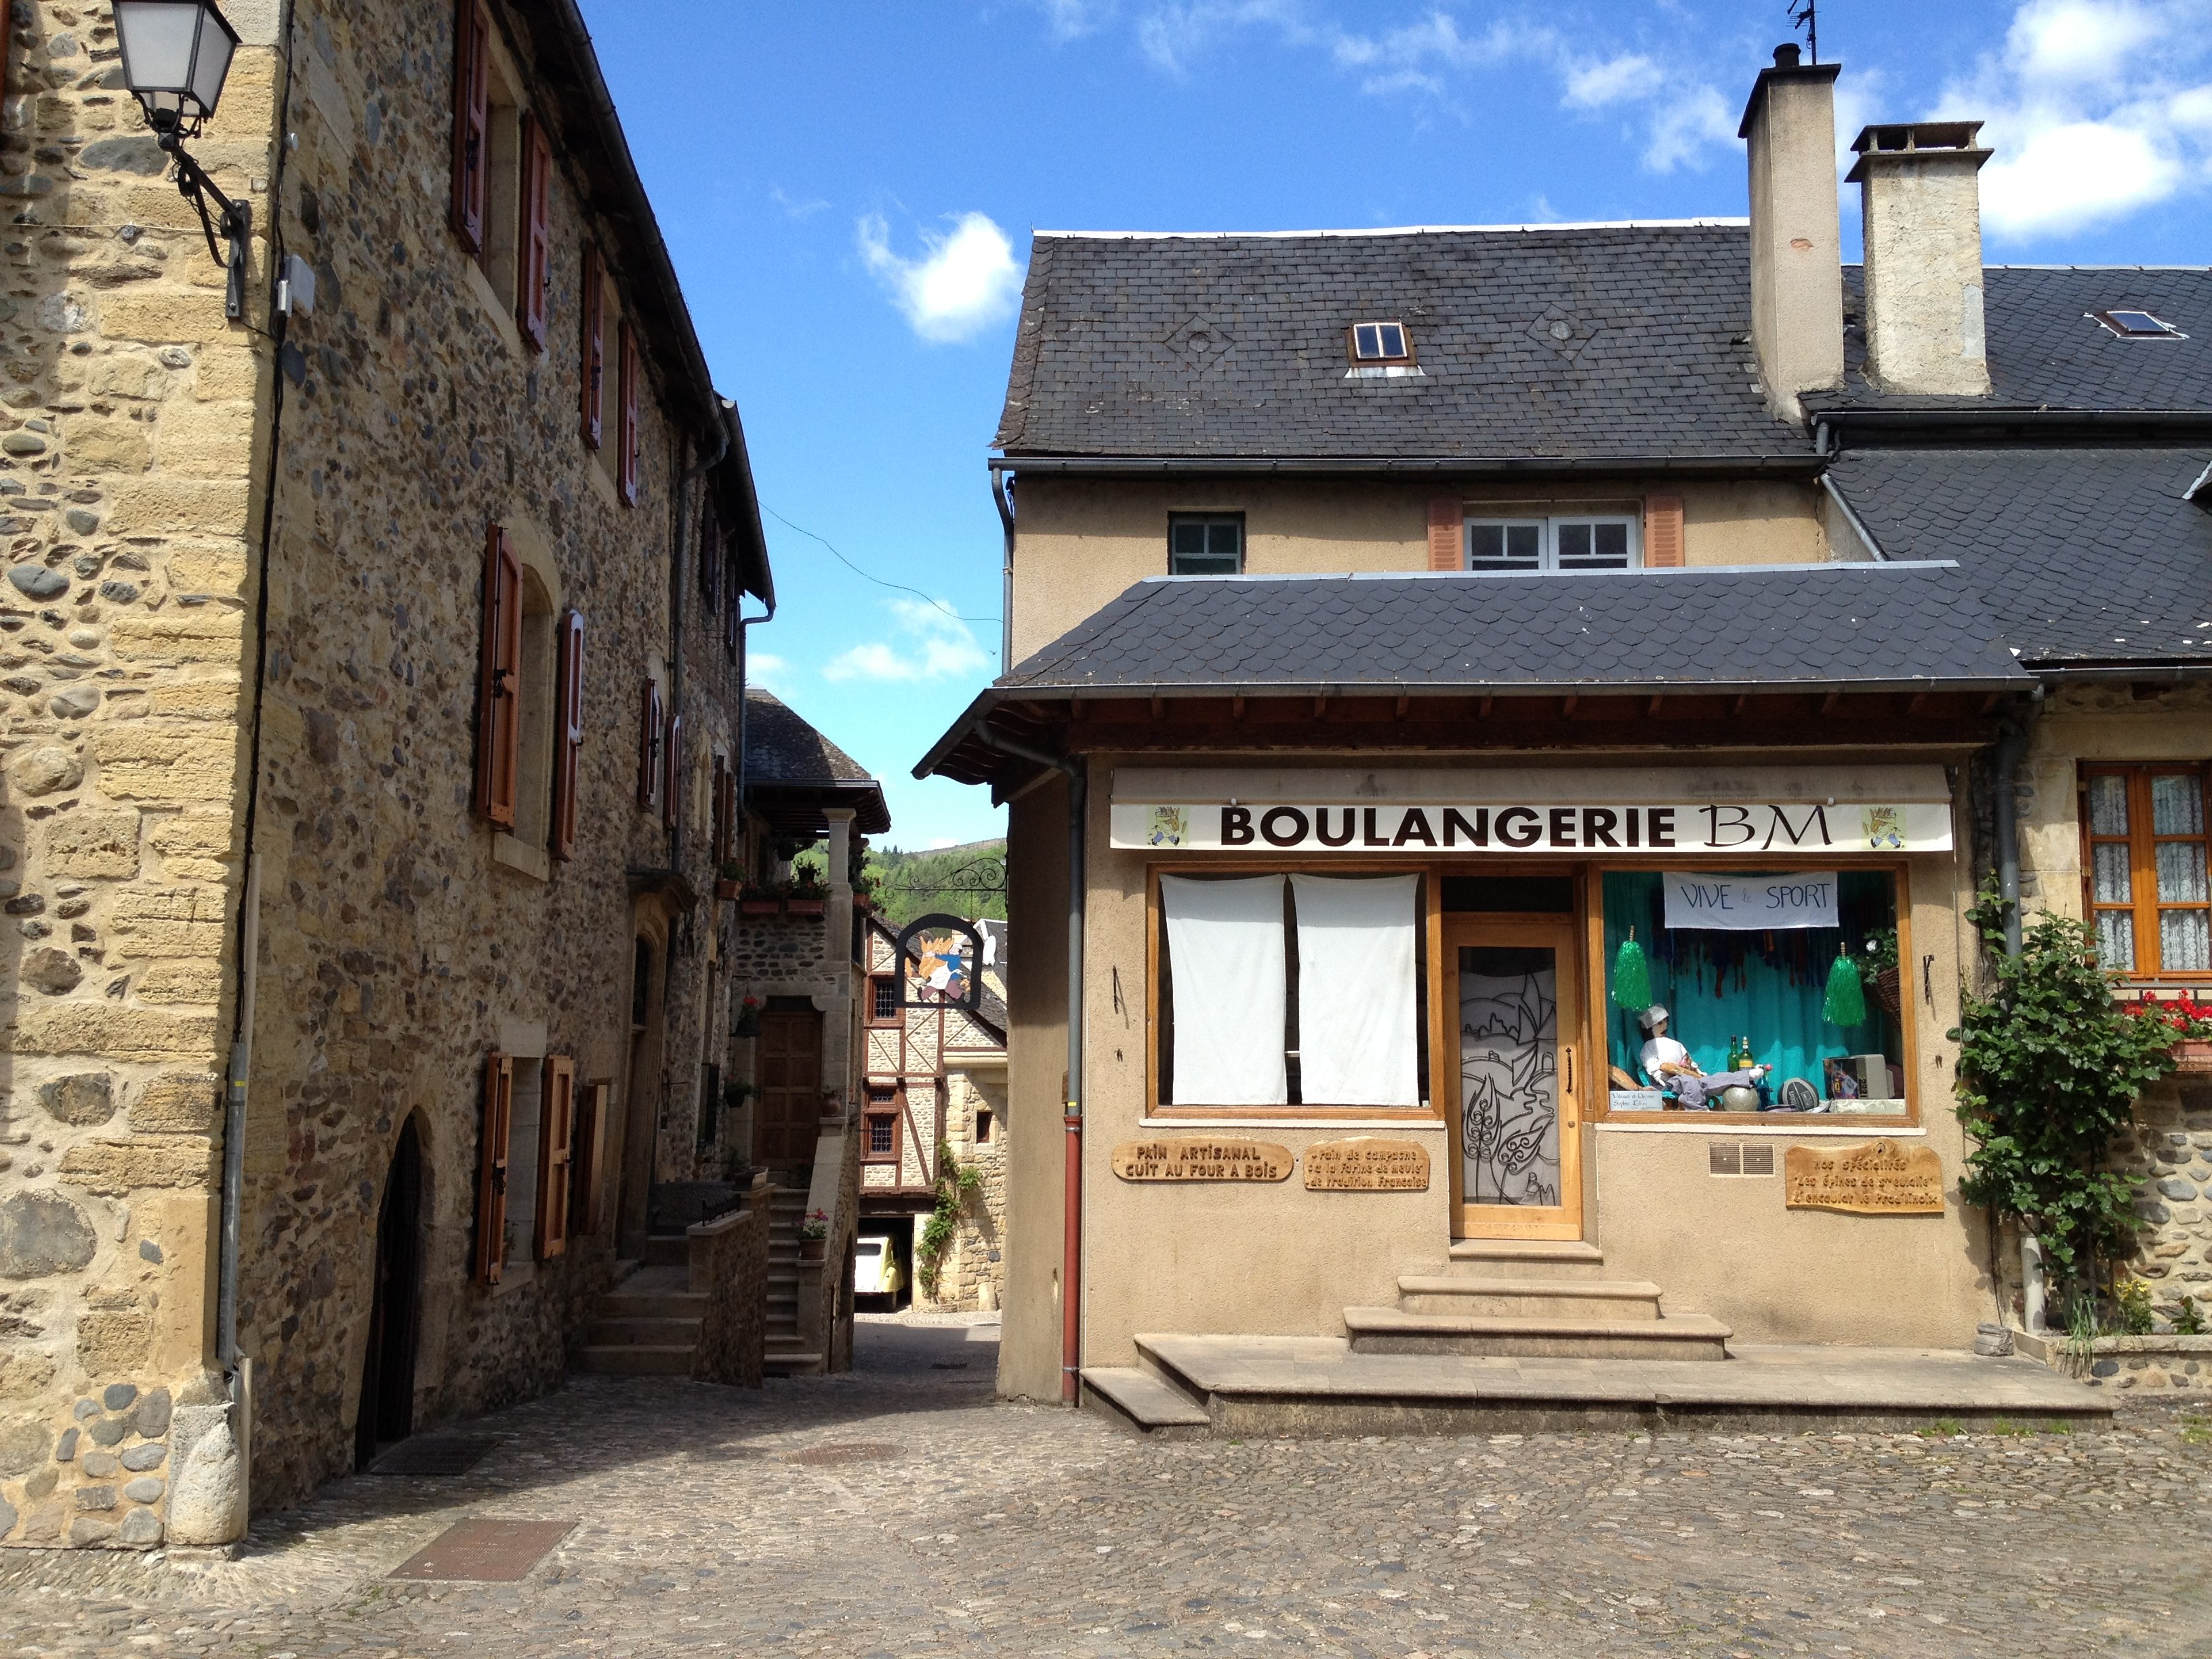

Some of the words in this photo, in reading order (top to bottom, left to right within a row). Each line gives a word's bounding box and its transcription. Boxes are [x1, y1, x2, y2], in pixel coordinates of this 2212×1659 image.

[1221, 806, 1676, 848] BOULANGERIE
[1698, 804, 1833, 850] BM
[1680, 883, 1734, 909] VIVE
[1741, 888, 1753, 903] le
[1765, 883, 1830, 909] SPORT
[1136, 1143, 1168, 1160] PAIN
[1180, 1143, 1261, 1161] ARTISANAL
[1347, 1149, 1359, 1160] de
[1125, 1162, 1159, 1176] CUIT
[1164, 1164, 1183, 1176] AU
[1189, 1163, 1225, 1177] FOUR
[1230, 1163, 1240, 1178] A
[1245, 1161, 1277, 1178] BOIS
[1326, 1162, 1336, 1174] la
[1376, 1163, 1388, 1174] de
[1310, 1176, 1322, 1187] de
[1525, 1172, 1556, 1206] BM
